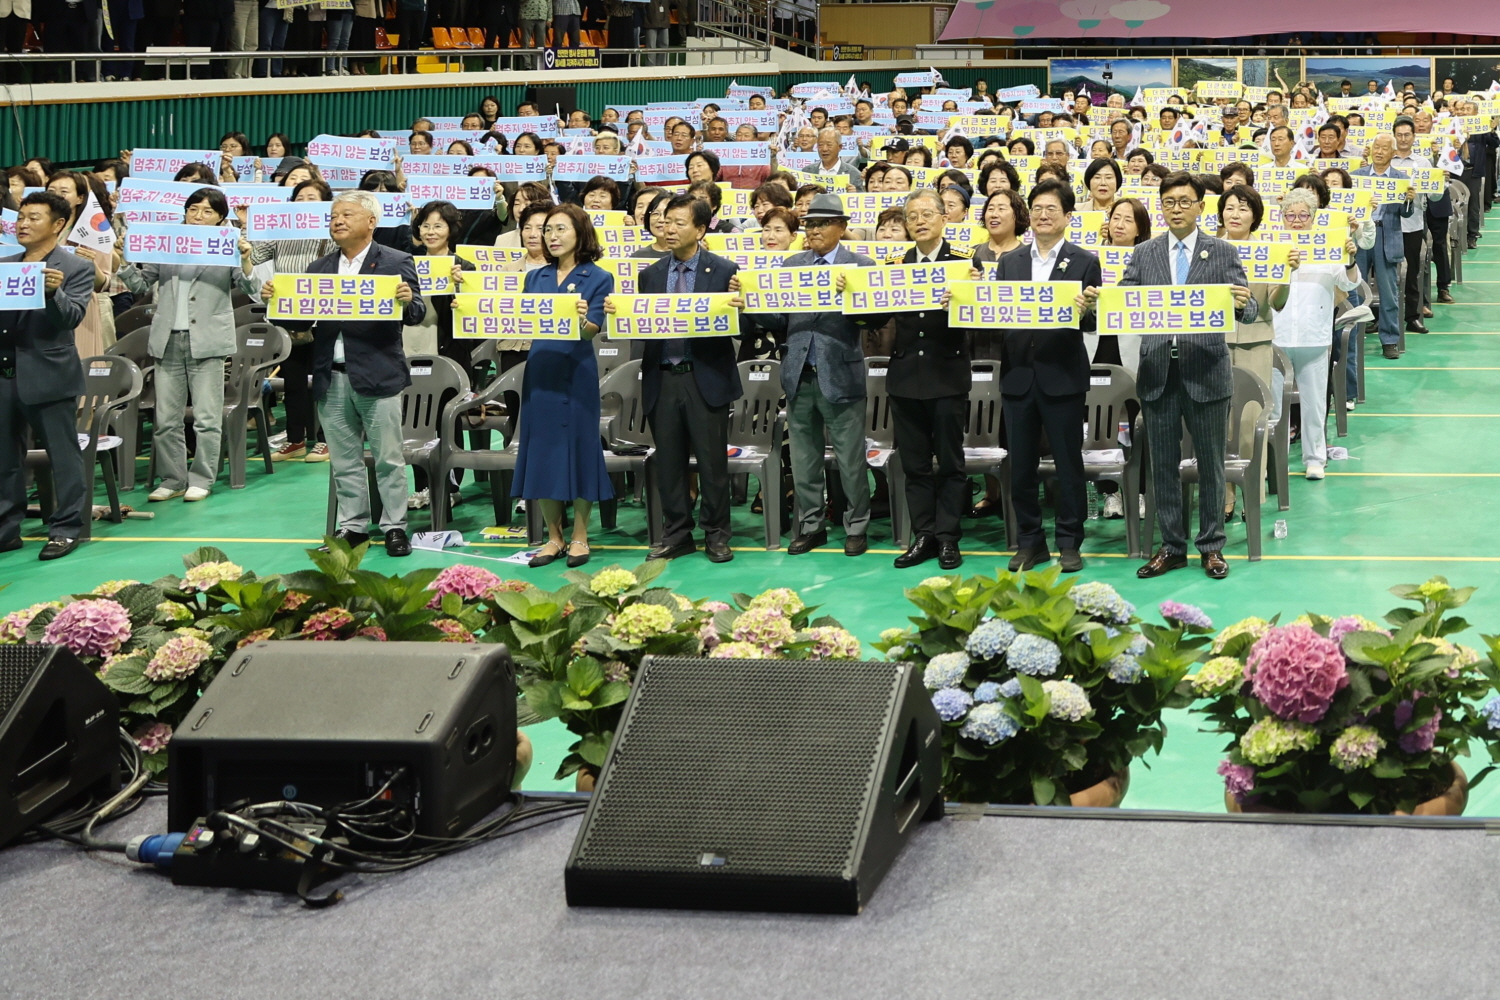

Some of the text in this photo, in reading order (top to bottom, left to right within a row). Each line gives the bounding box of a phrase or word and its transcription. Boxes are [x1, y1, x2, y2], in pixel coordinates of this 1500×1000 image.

[308, 143, 391, 161] 멈추지 않는 보성
[403, 162, 450, 174] 멈추지 않는
[558, 163, 624, 174] 멈추지 않는 보성
[411, 185, 490, 200] 멈추지 않는 보성
[254, 213, 320, 230] 멈추지 않는
[130, 235, 234, 255] 멈추지 않는 보성
[1298, 233, 1325, 244] 보성
[1314, 248, 1341, 260] 보성
[868, 267, 945, 287] 더 큰 보성
[1254, 264, 1284, 278] 보성
[6, 276, 35, 296] 보성
[297, 279, 374, 295] 더 큰 보성
[419, 275, 448, 291] 보성
[759, 270, 830, 289] 더 큰 보성
[746, 292, 812, 308] 더 힘있는
[852, 289, 925, 308] 더 힘있는
[977, 286, 1053, 302] 더 큰 보성
[1125, 290, 1204, 307] 더 큰 보성
[278, 298, 393, 314] 더 힘있는 보성
[479, 298, 552, 314] 더 큰 보성
[634, 298, 709, 313] 더 큰 보성
[959, 306, 1072, 323] 더 힘있는 보성
[1107, 310, 1224, 329] 더 힘있는 보성
[463, 317, 570, 335] 더 힘있는 보성
[616, 315, 728, 333] 더 힘있는 보성
